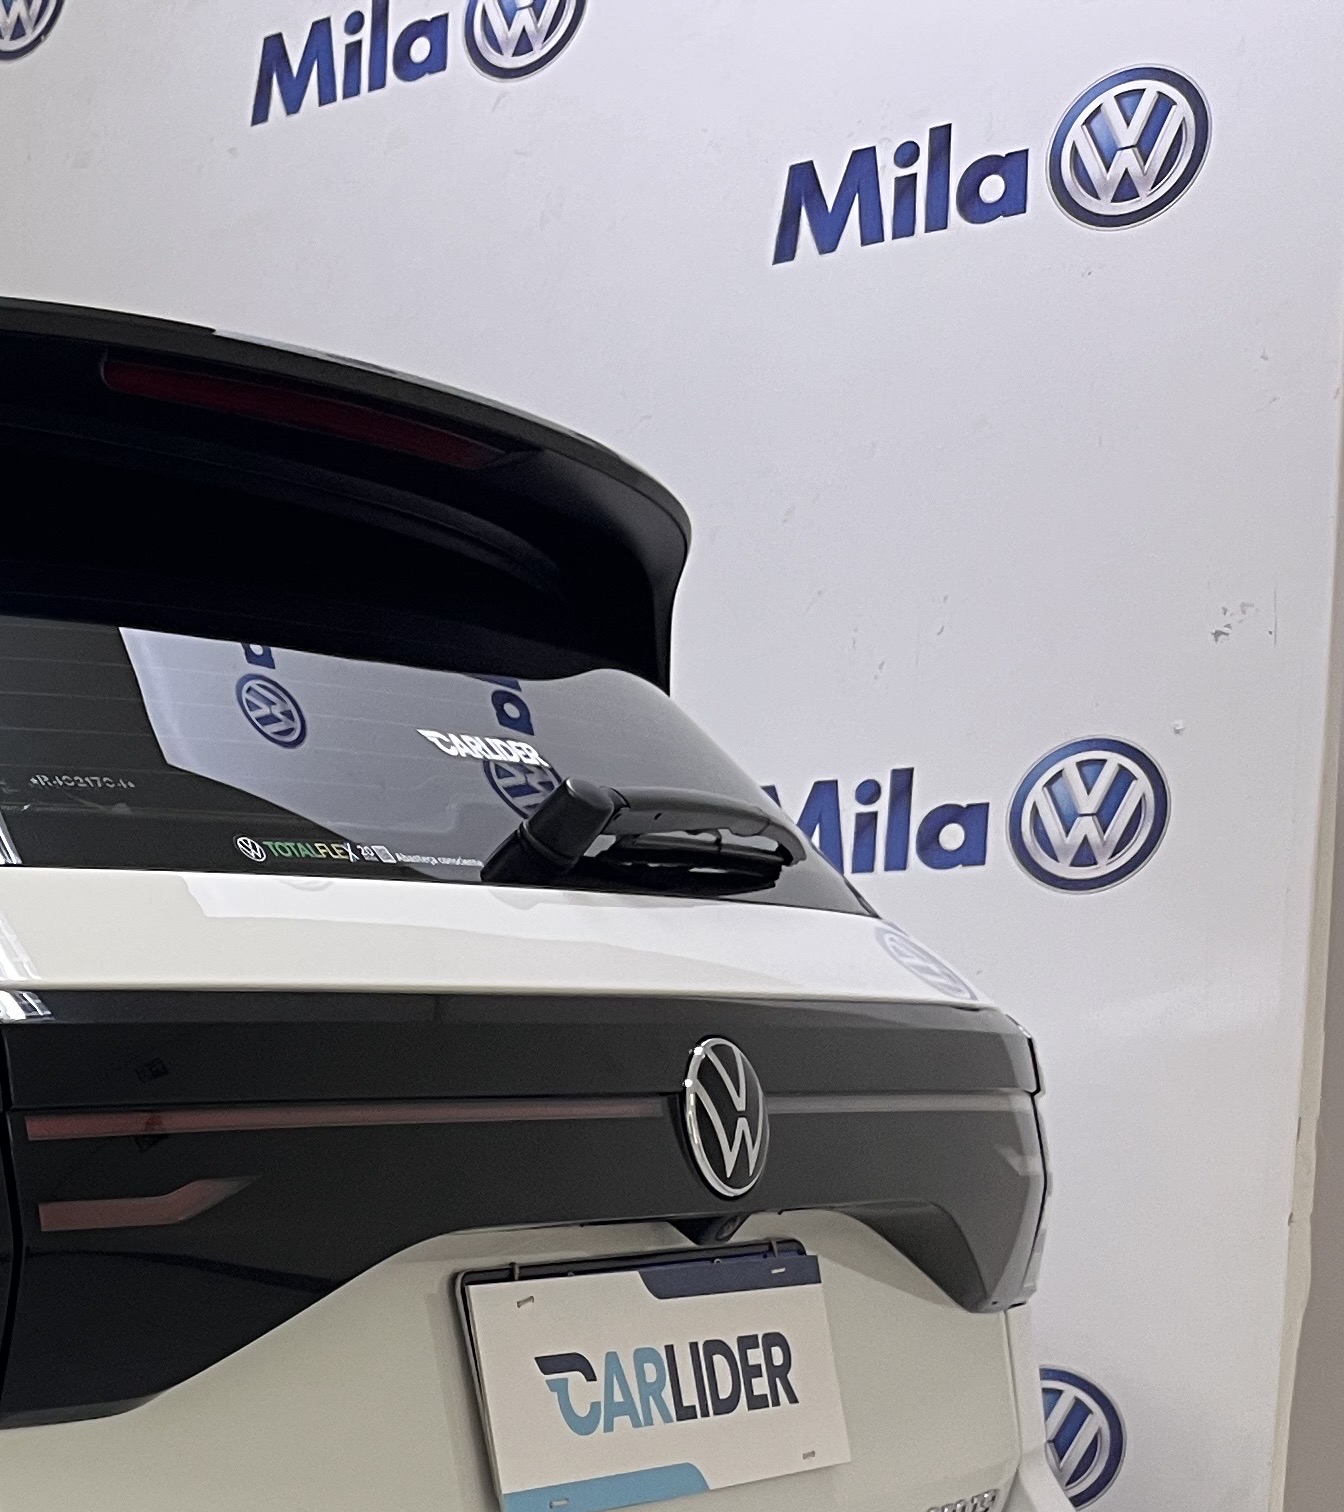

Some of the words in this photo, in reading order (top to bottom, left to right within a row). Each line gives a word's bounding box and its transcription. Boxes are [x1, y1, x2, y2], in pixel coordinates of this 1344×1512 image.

[250, 0, 449, 127] Mila
[772, 123, 1029, 266] Mila
[416, 728, 550, 768] CARLIDER
[534, 1331, 799, 1436] CARLIDER
